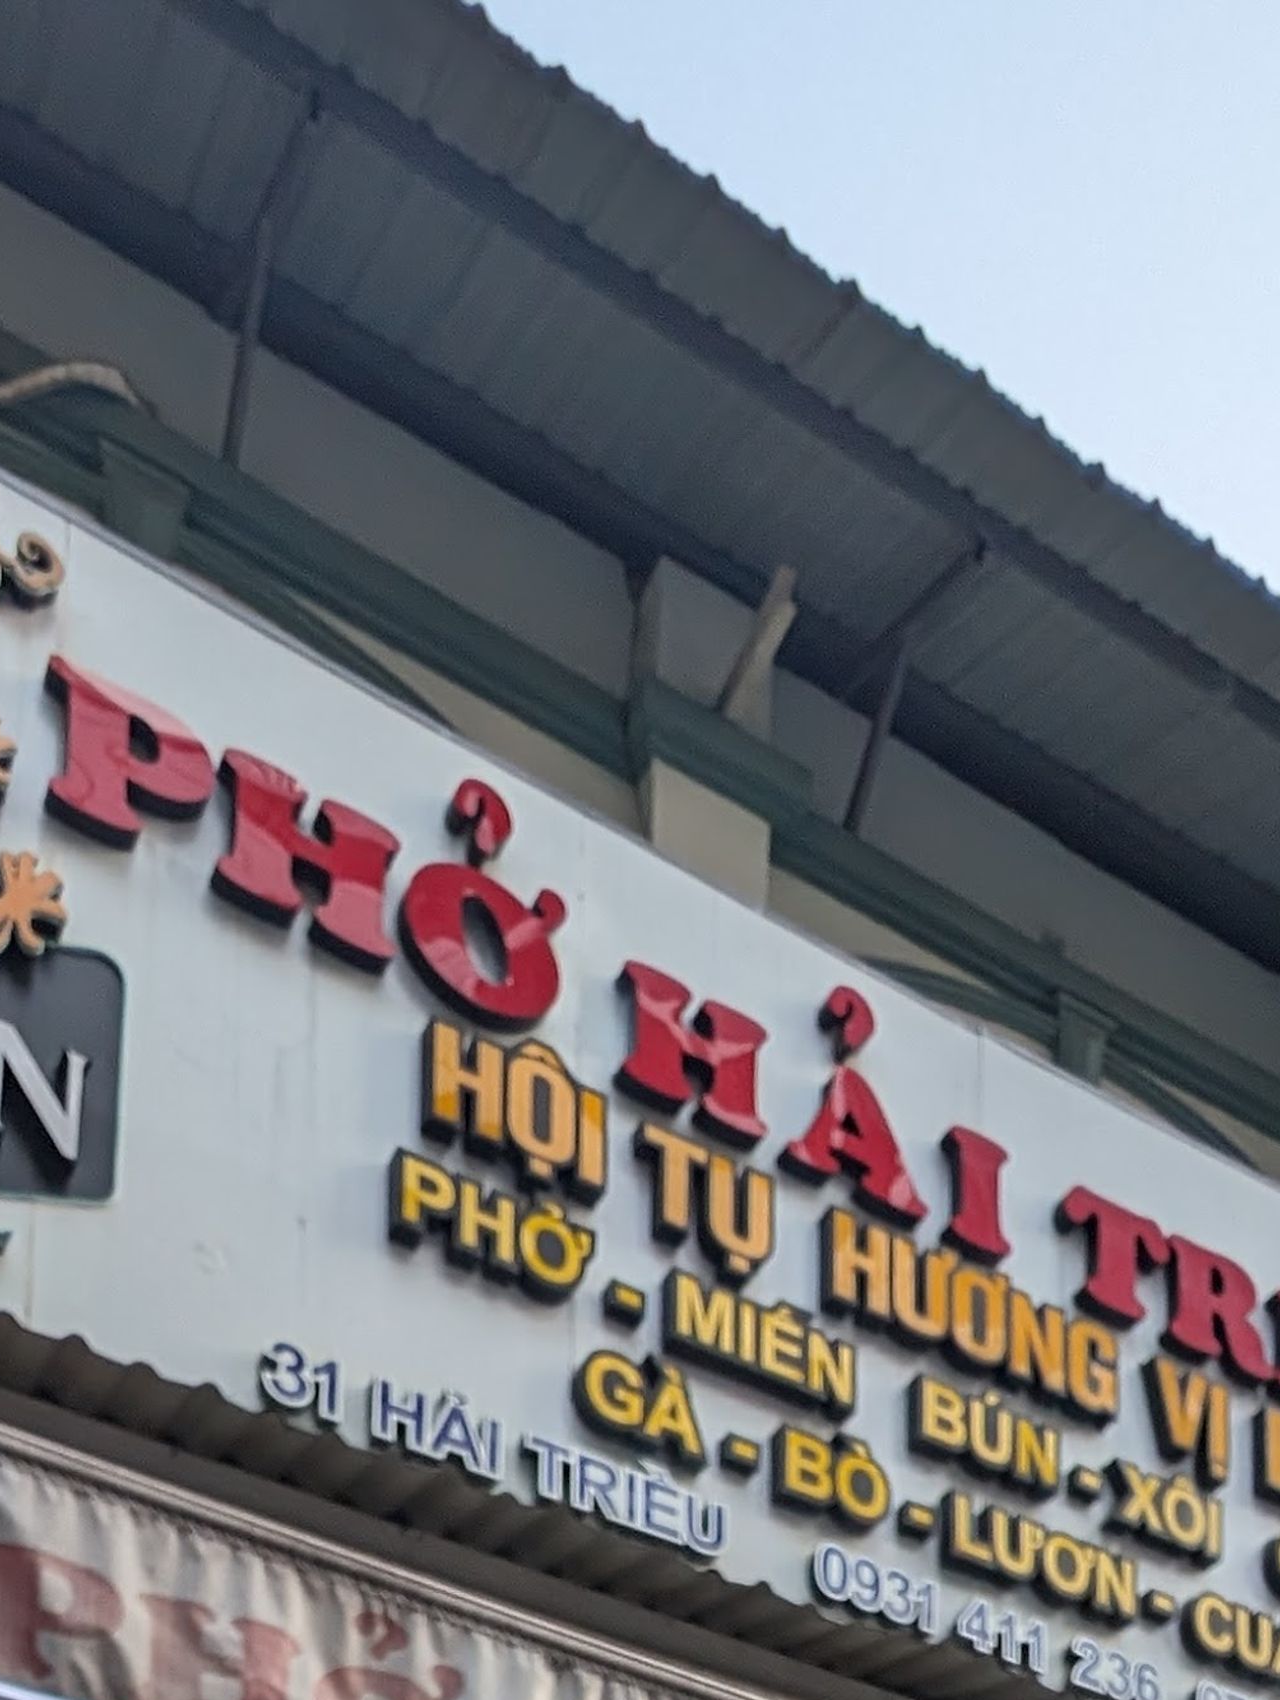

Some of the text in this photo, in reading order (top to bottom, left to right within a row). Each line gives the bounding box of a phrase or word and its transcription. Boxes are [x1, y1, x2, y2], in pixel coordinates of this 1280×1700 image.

[45, 654, 566, 1031] PHỞ
[614, 960, 1010, 1259] HẢI
[394, 1149, 596, 1296] PHỞ
[910, 1375, 1060, 1495] BÚN
[1108, 1460, 1222, 1564] XÔI
[425, 1019, 606, 1203] HỘI
[636, 1125, 774, 1278] TỤ
[822, 1206, 1119, 1420] HƯƠNG
[1142, 1355, 1230, 1488] VỊ
[260, 1343, 345, 1424] 31
[372, 1377, 504, 1481] HẢI
[522, 1431, 728, 1556] TRIỀU
[814, 1543, 937, 1634] 0931
[958, 1599, 1048, 1674] 411
[574, 1349, 706, 1470] GÀ
[776, 1424, 889, 1526] BÒ
[944, 1491, 1137, 1625] LƯƠN
